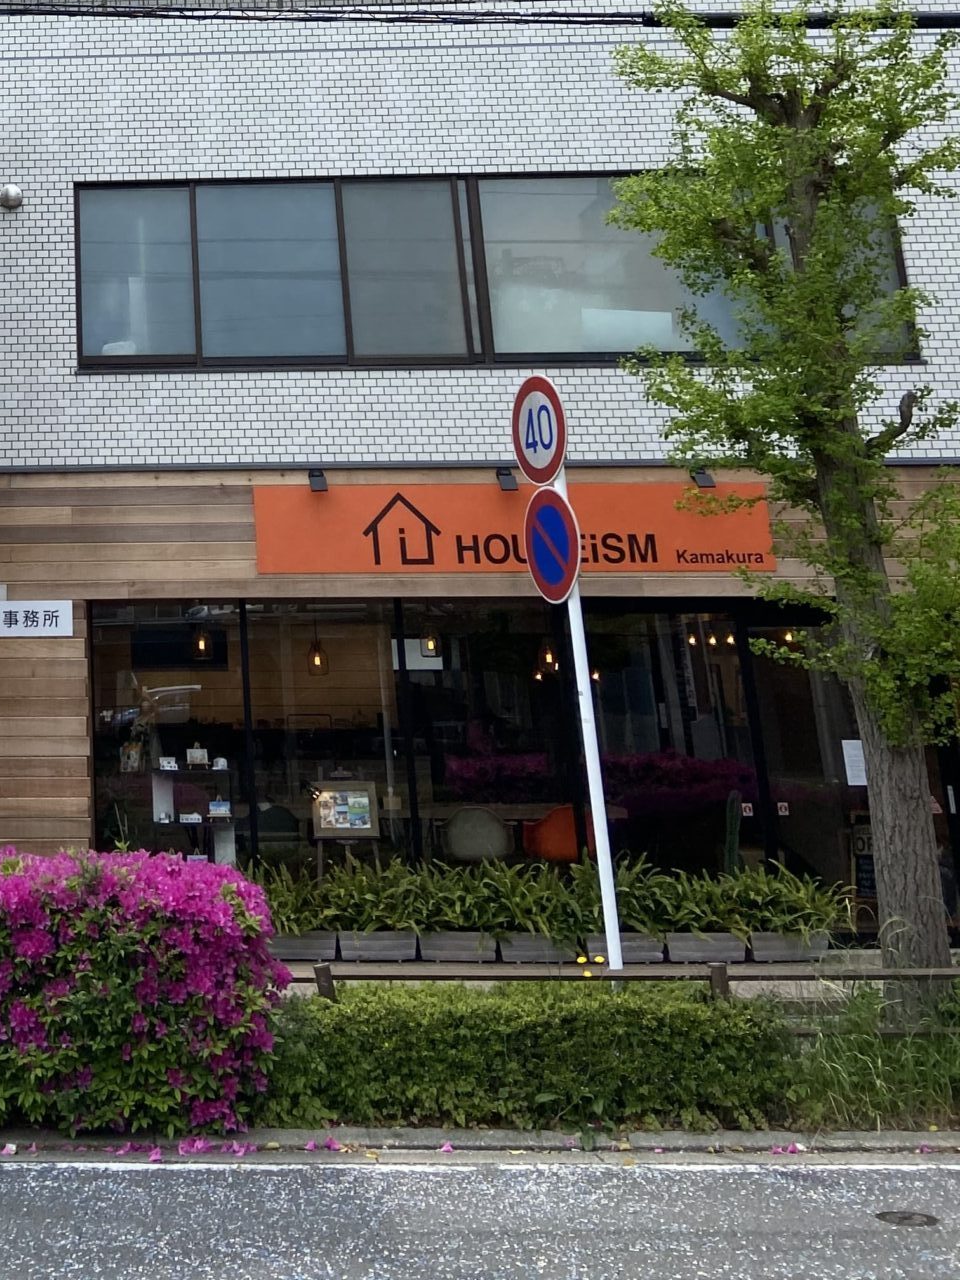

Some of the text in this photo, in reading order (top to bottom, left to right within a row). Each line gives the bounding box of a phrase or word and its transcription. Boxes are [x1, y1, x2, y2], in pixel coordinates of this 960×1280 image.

[525, 404, 554, 454] 40
[455, 532, 765, 565] HOUiSM Kamakura
